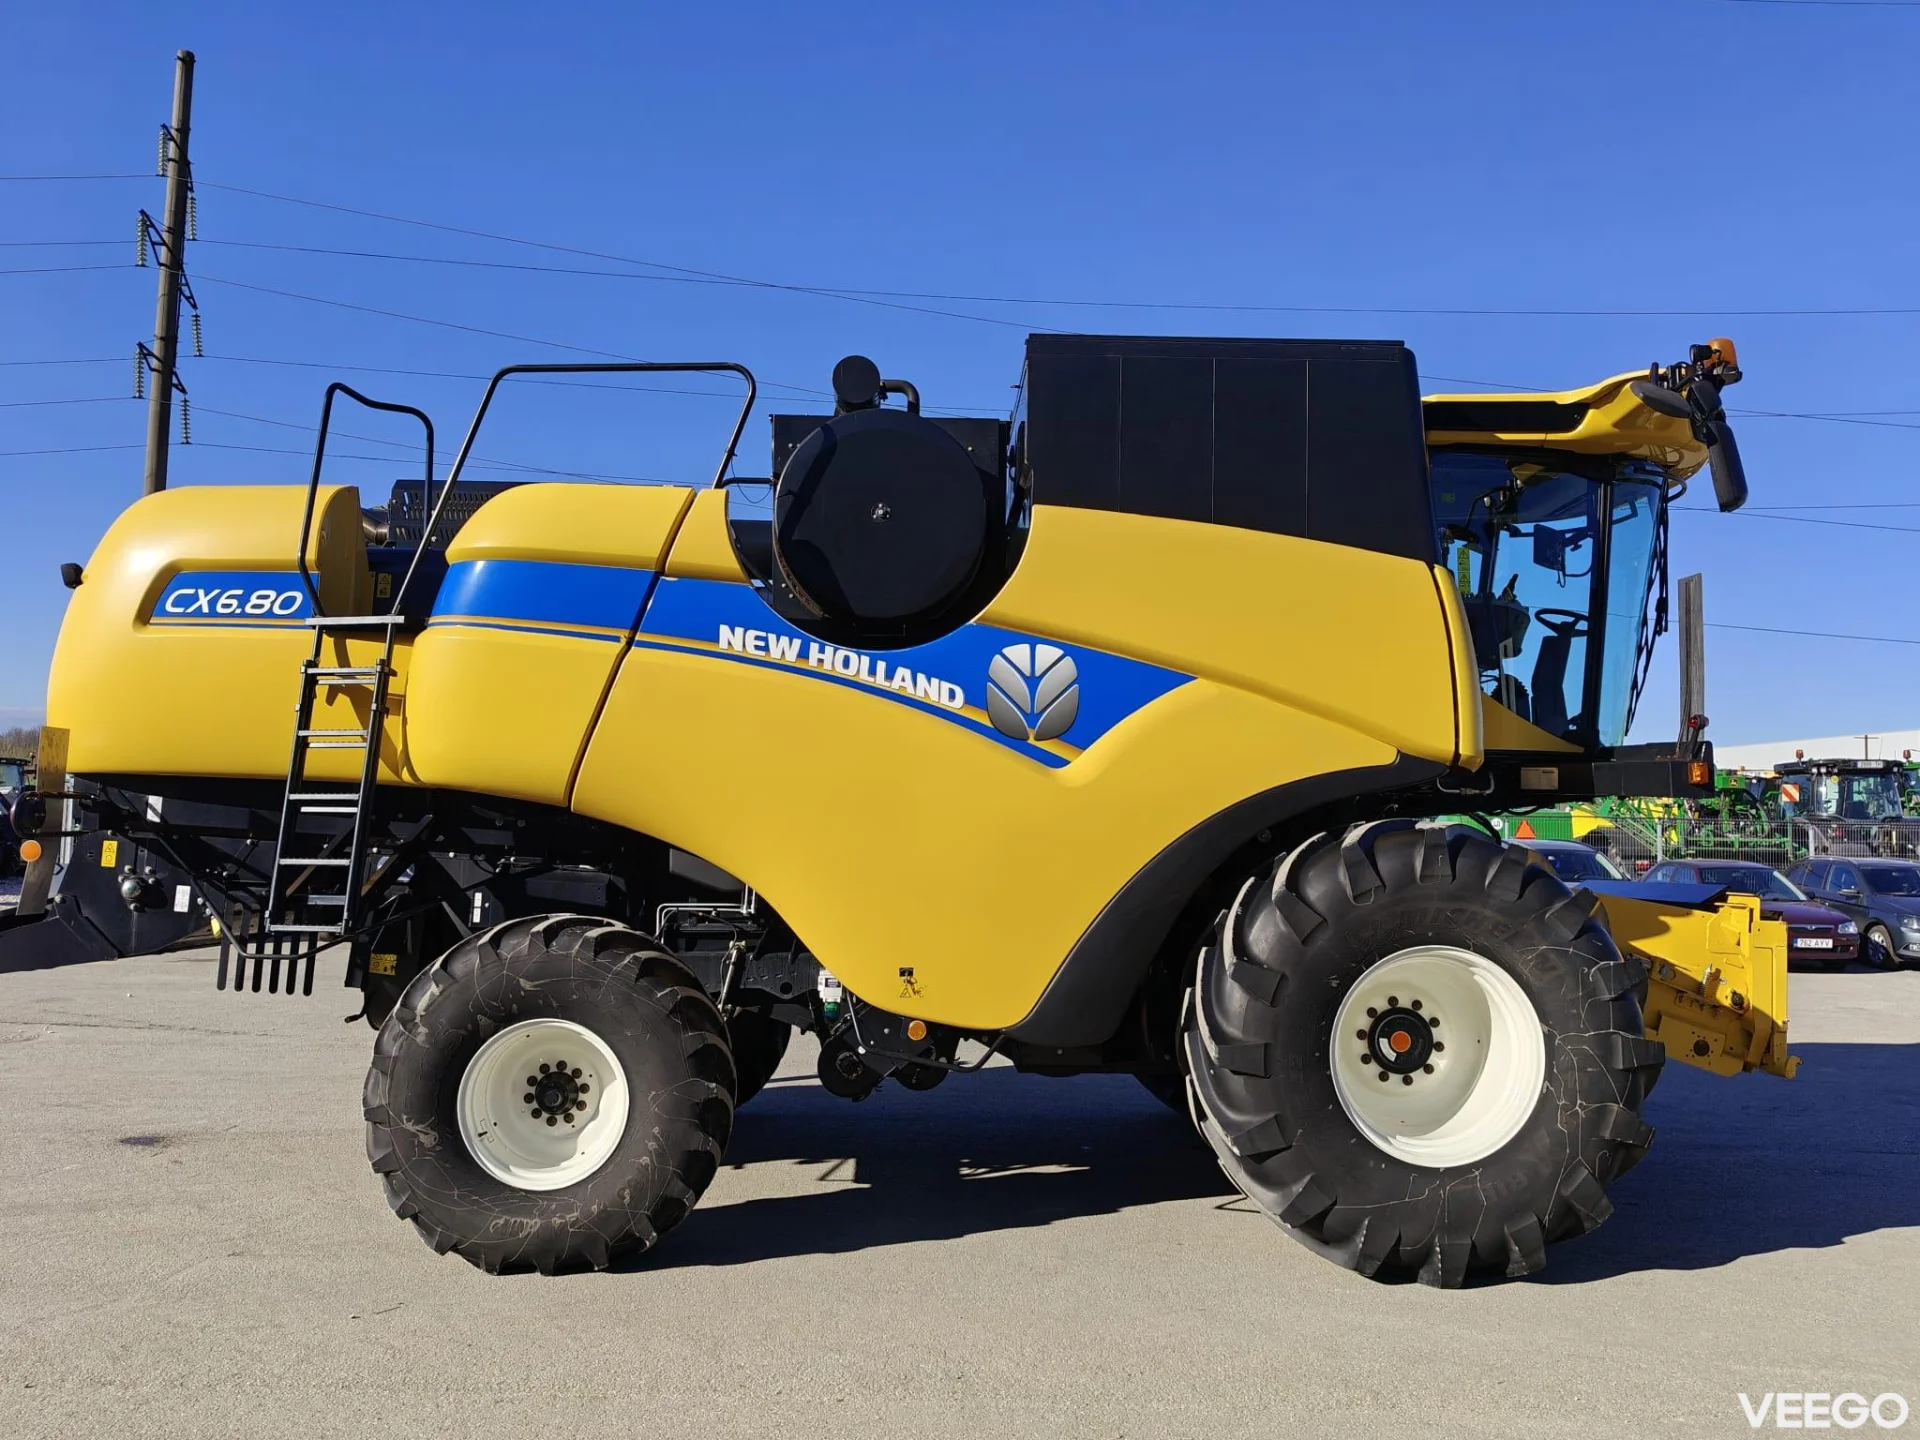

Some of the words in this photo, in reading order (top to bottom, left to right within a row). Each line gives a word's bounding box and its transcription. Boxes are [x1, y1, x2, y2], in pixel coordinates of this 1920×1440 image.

[165, 588, 303, 615] CX6.80
[718, 624, 802, 662] NEW
[808, 642, 965, 709] HOLLAND
